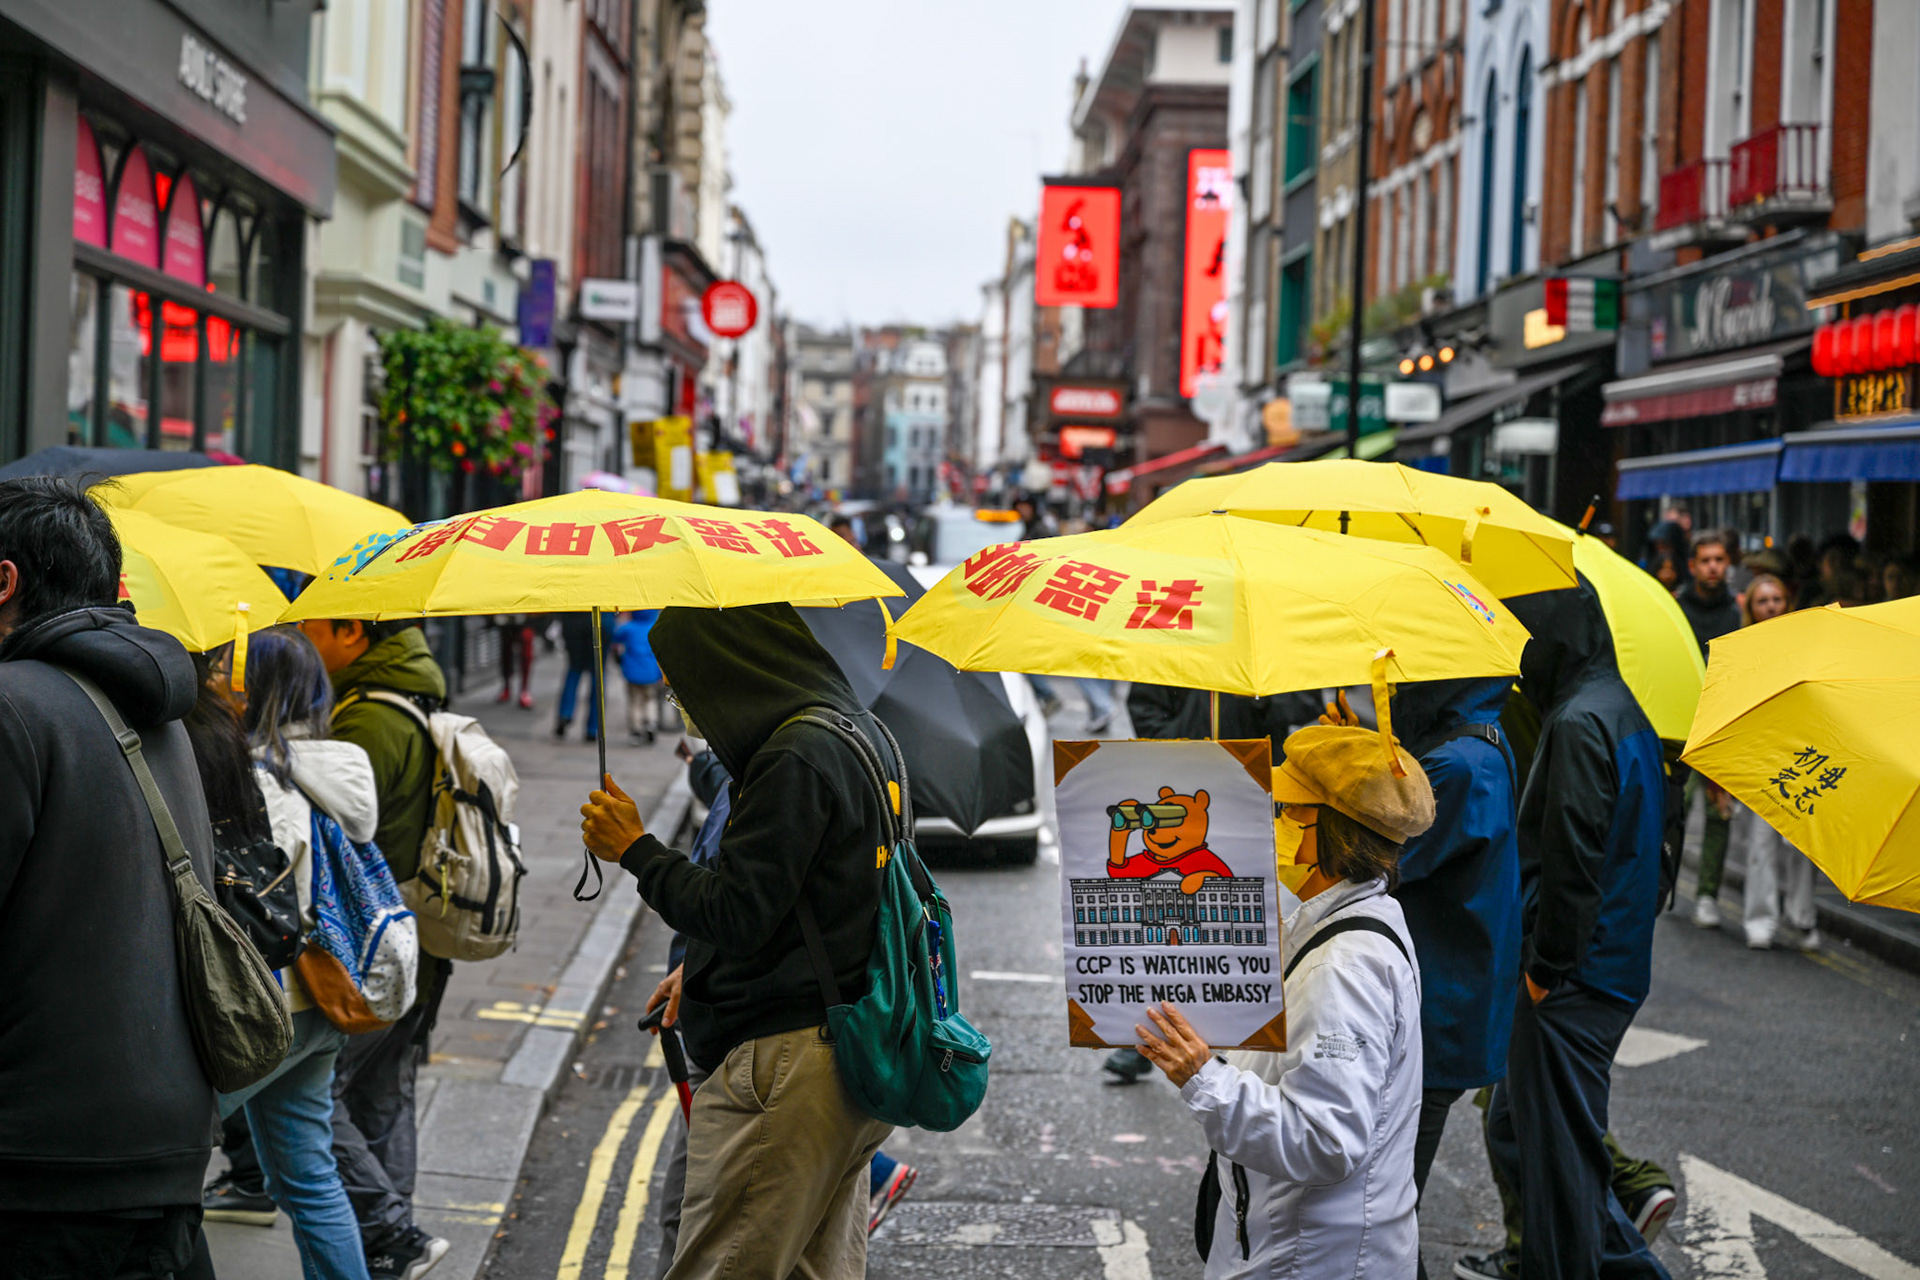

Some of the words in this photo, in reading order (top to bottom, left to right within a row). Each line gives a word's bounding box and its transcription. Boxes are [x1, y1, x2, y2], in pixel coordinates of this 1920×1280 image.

[1076, 956, 1112, 975] CCP
[1119, 956, 1136, 975] IS
[1142, 955, 1230, 975] WATCHING
[1237, 955, 1271, 975] YOU
[1078, 984, 1114, 1004] STOP
[1118, 984, 1145, 1003] THE
[1151, 983, 1197, 1003] MEGA
[1203, 983, 1272, 1004] EMBASSY
